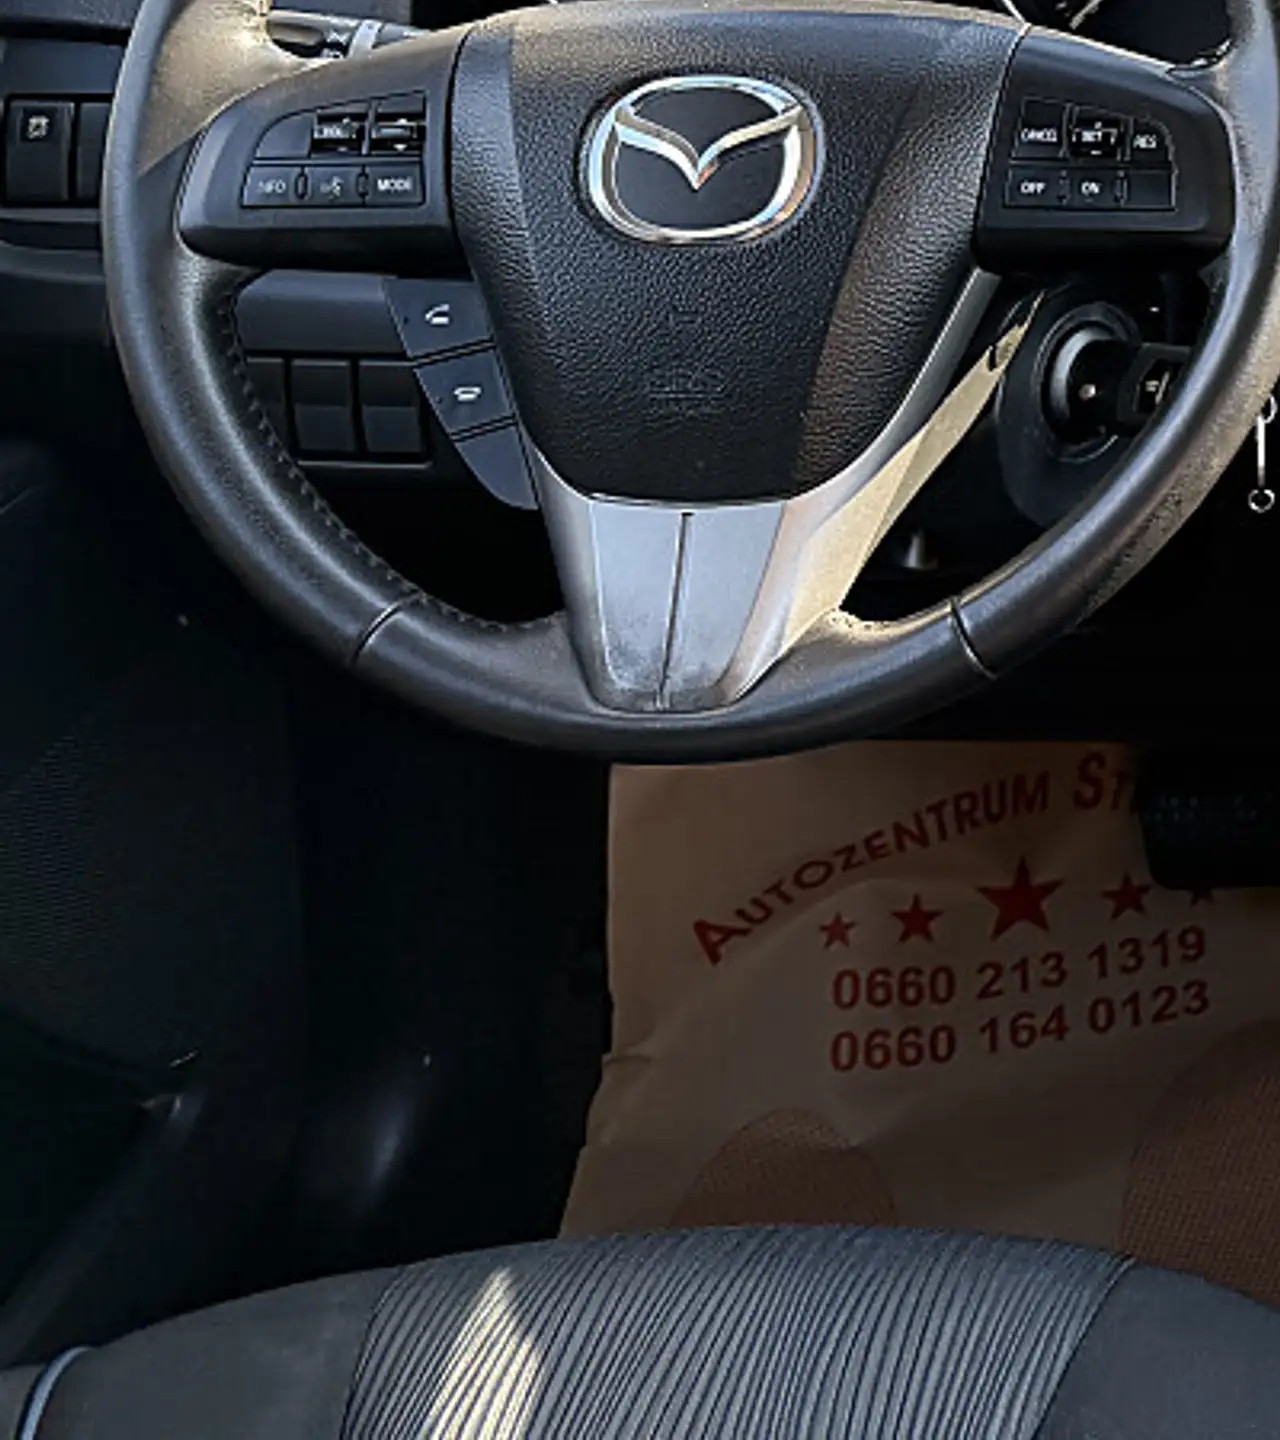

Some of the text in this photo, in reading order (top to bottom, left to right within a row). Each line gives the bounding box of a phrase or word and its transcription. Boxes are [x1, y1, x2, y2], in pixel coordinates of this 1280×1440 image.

[377, 178, 412, 192] MODE
[1020, 180, 1046, 194] OFF
[1081, 180, 1102, 194] ON
[691, 768, 1050, 967] AUTOZENTRUM
[831, 924, 1206, 1012] 0660 213 1319
[829, 979, 1210, 1073] 0660 164 0123
